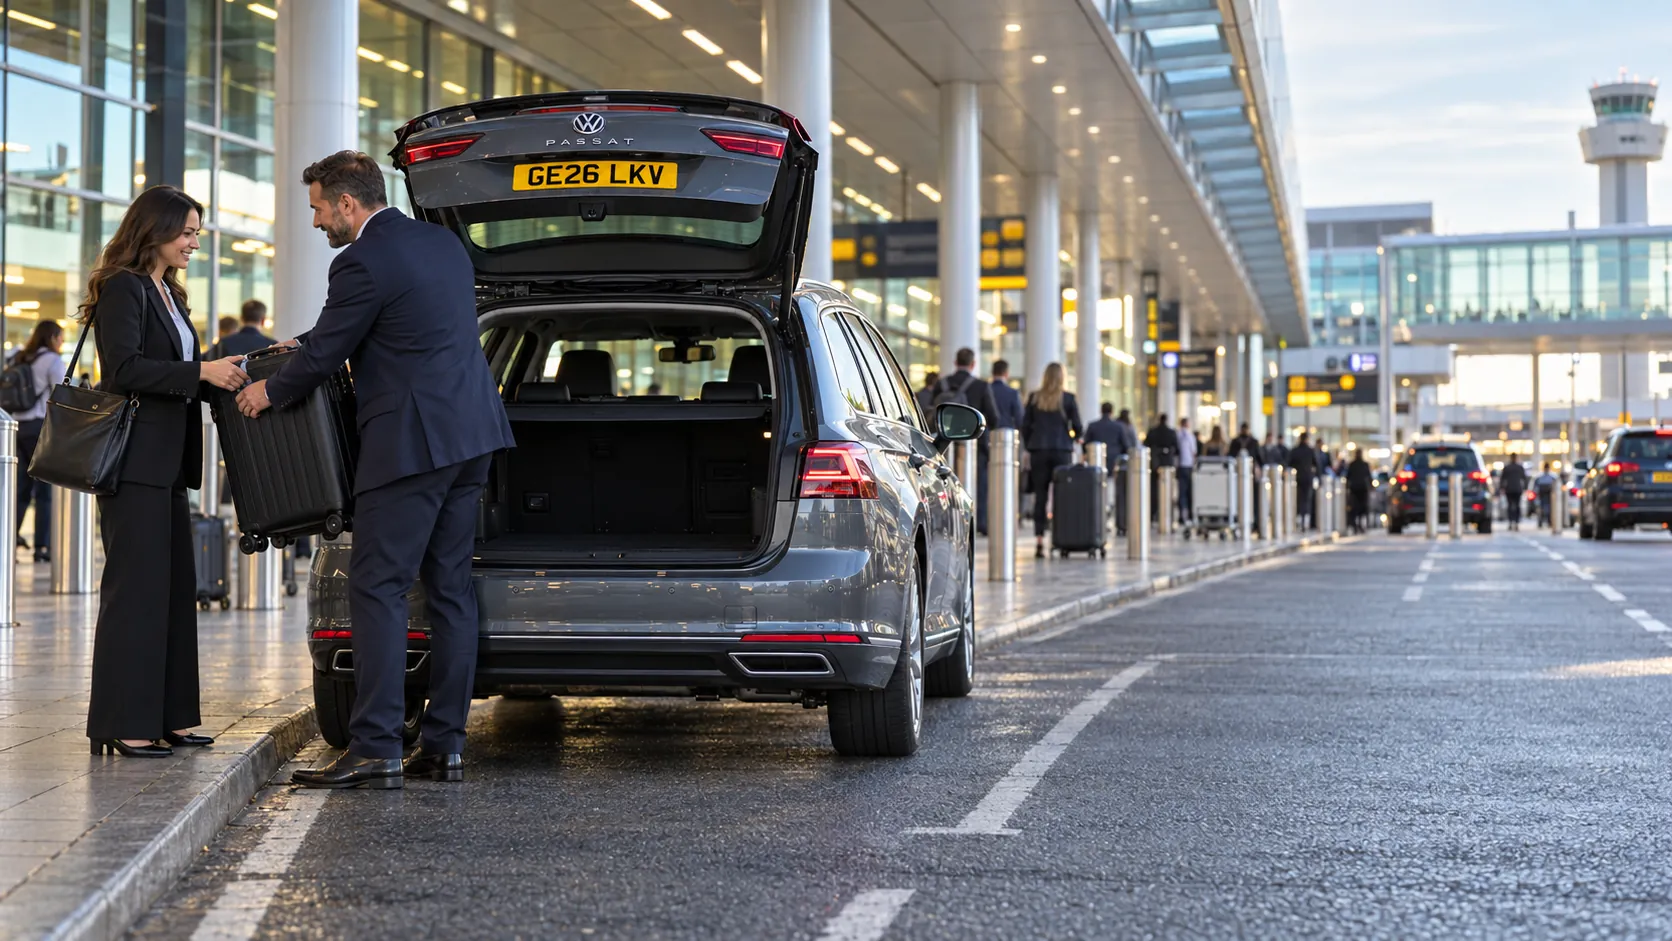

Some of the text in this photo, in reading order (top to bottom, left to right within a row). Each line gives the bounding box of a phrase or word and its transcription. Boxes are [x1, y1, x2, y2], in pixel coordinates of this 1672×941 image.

[573, 112, 604, 134] VW
[546, 137, 634, 146] PASSAT
[528, 163, 664, 186] GE26 LKV
